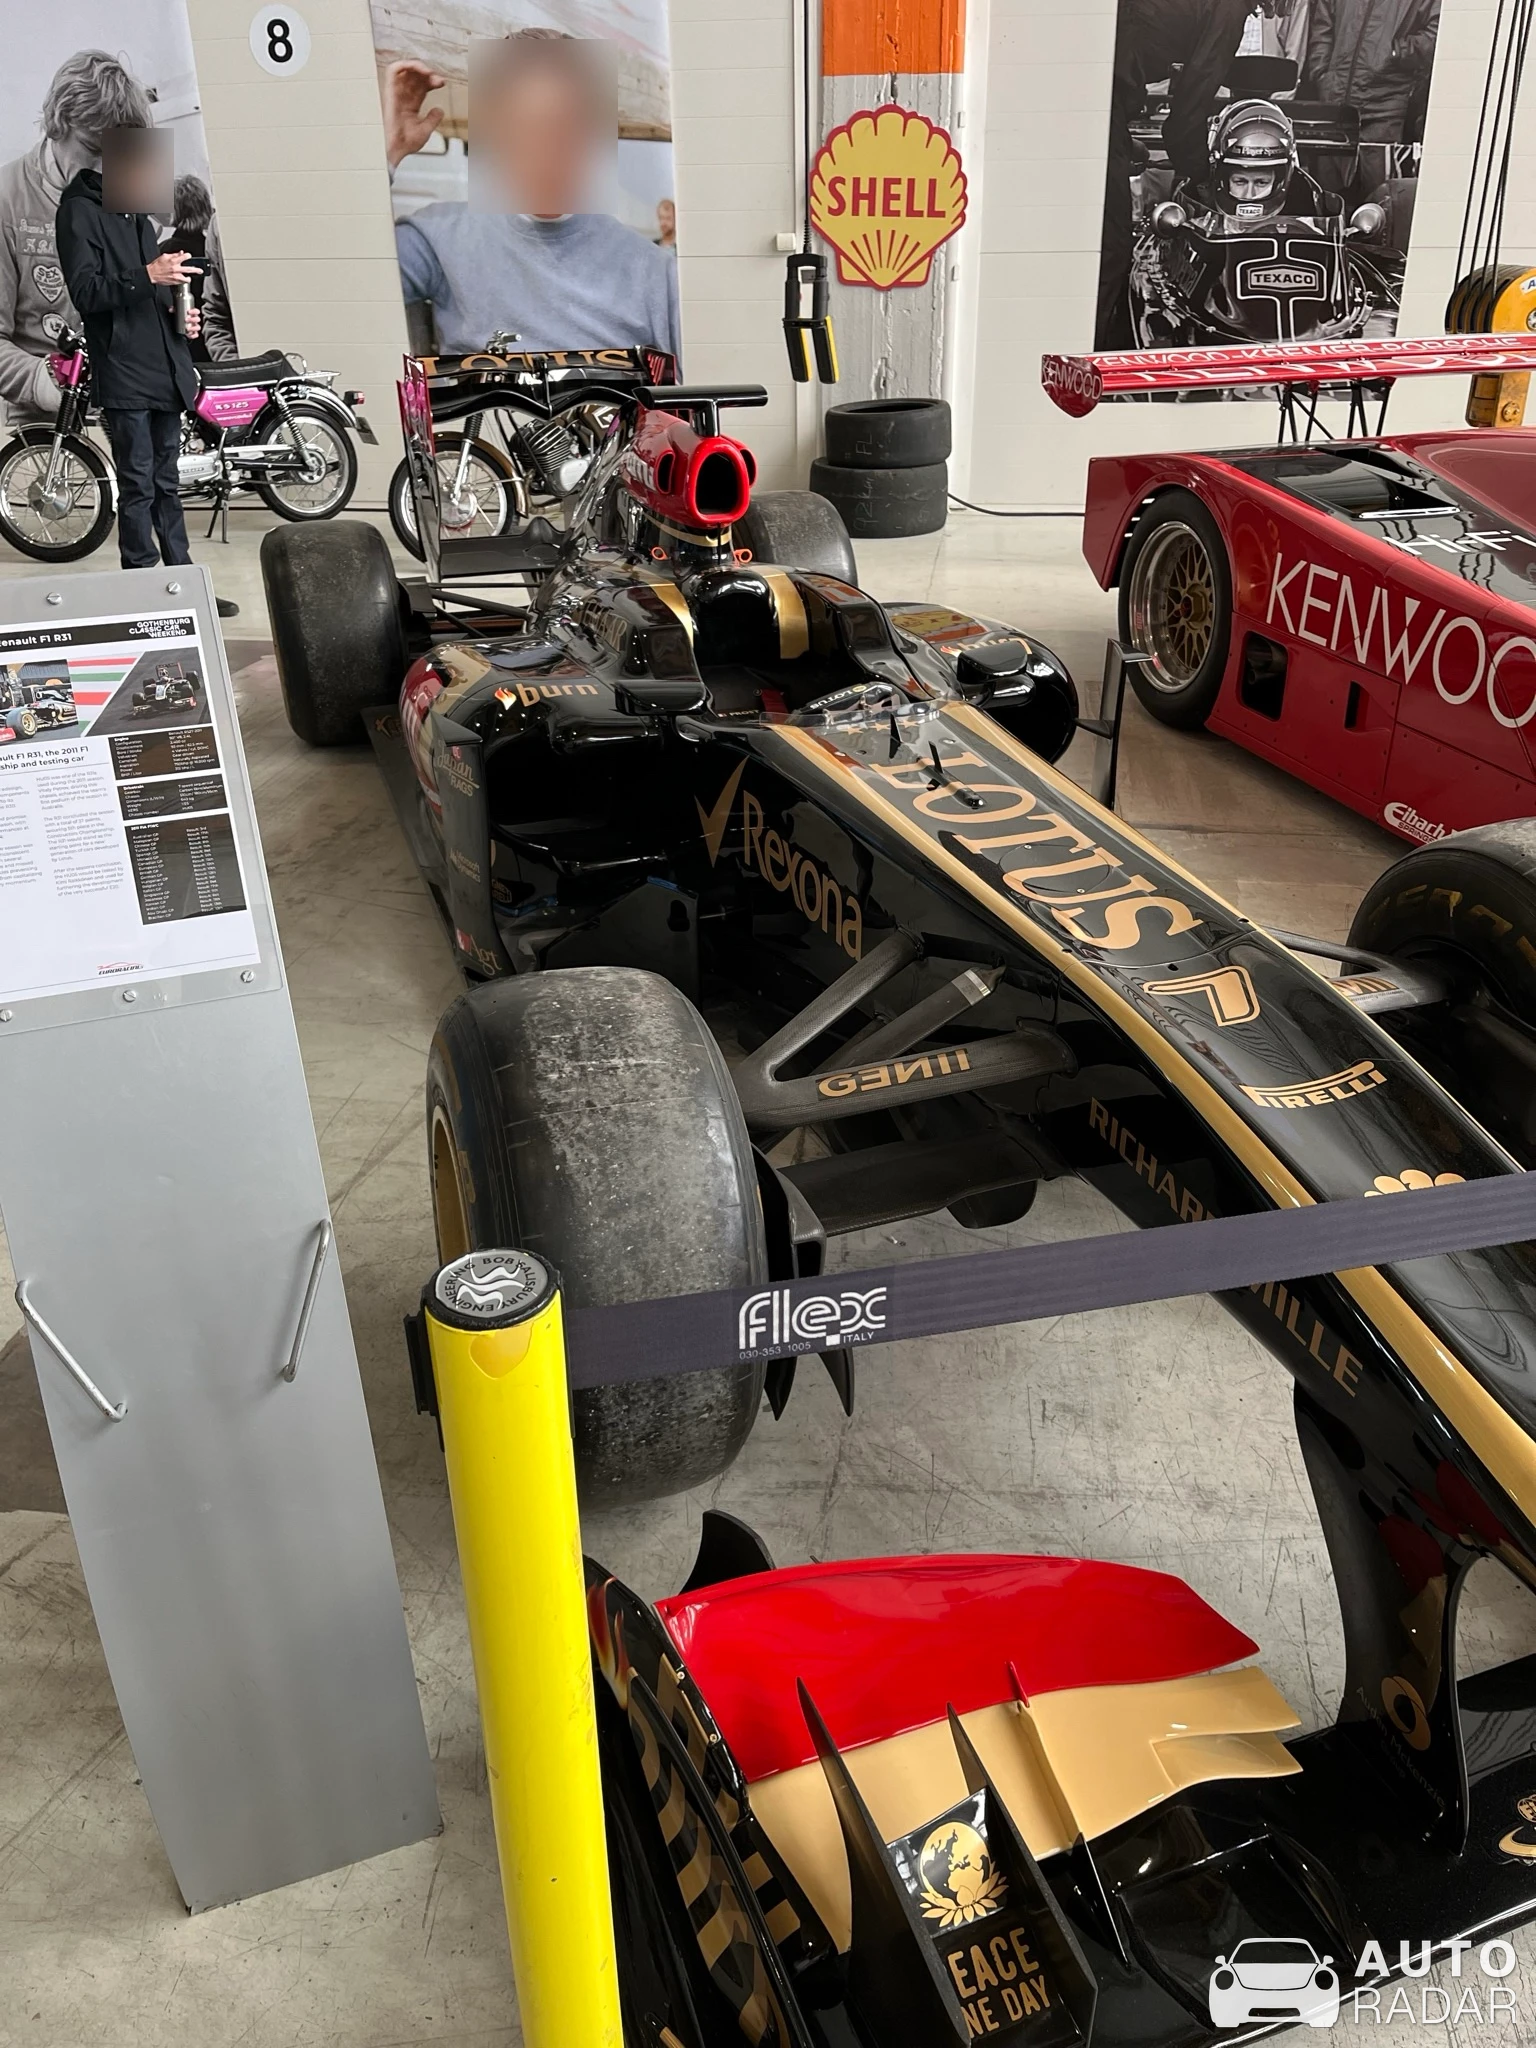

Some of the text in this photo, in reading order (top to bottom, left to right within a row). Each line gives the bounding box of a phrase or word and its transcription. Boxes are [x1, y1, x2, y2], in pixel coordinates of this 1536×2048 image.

[267, 18, 292, 63] 8
[828, 175, 947, 219] SHELL
[1239, 207, 1261, 215] TEXACO
[37, 267, 59, 279] SEX
[1253, 272, 1313, 285] TEXACO
[1041, 358, 1101, 399] KENWOOD
[128, 625, 162, 634] CLASSIC
[136, 617, 190, 627] GOTHENBURG
[148, 629, 187, 637] WEEKEND
[0, 632, 72, 646] enault F1 R31
[516, 683, 598, 707] burn
[809, 690, 853, 710] LOTUS
[20, 760, 37, 768] and
[39, 757, 69, 766] testing
[71, 755, 85, 763] car
[436, 740, 474, 783] Japan
[450, 776, 474, 797] RAGS
[1383, 801, 1446, 839] Eibach
[869, 751, 1204, 950] LOTUS
[743, 789, 862, 962] Rexona
[1142, 964, 1262, 1028] 7
[1238, 1060, 1388, 1109] PIRELLI
[1089, 1096, 1216, 1223] RICHAR
[445, 1256, 537, 1312] BOB SALISBURY ENGINEERING
[738, 1286, 887, 1350] flex
[739, 1341, 811, 1360] 030-353 1005
[843, 1331, 874, 1343] ITALY
[1000, 1975, 1051, 2022] DAY
